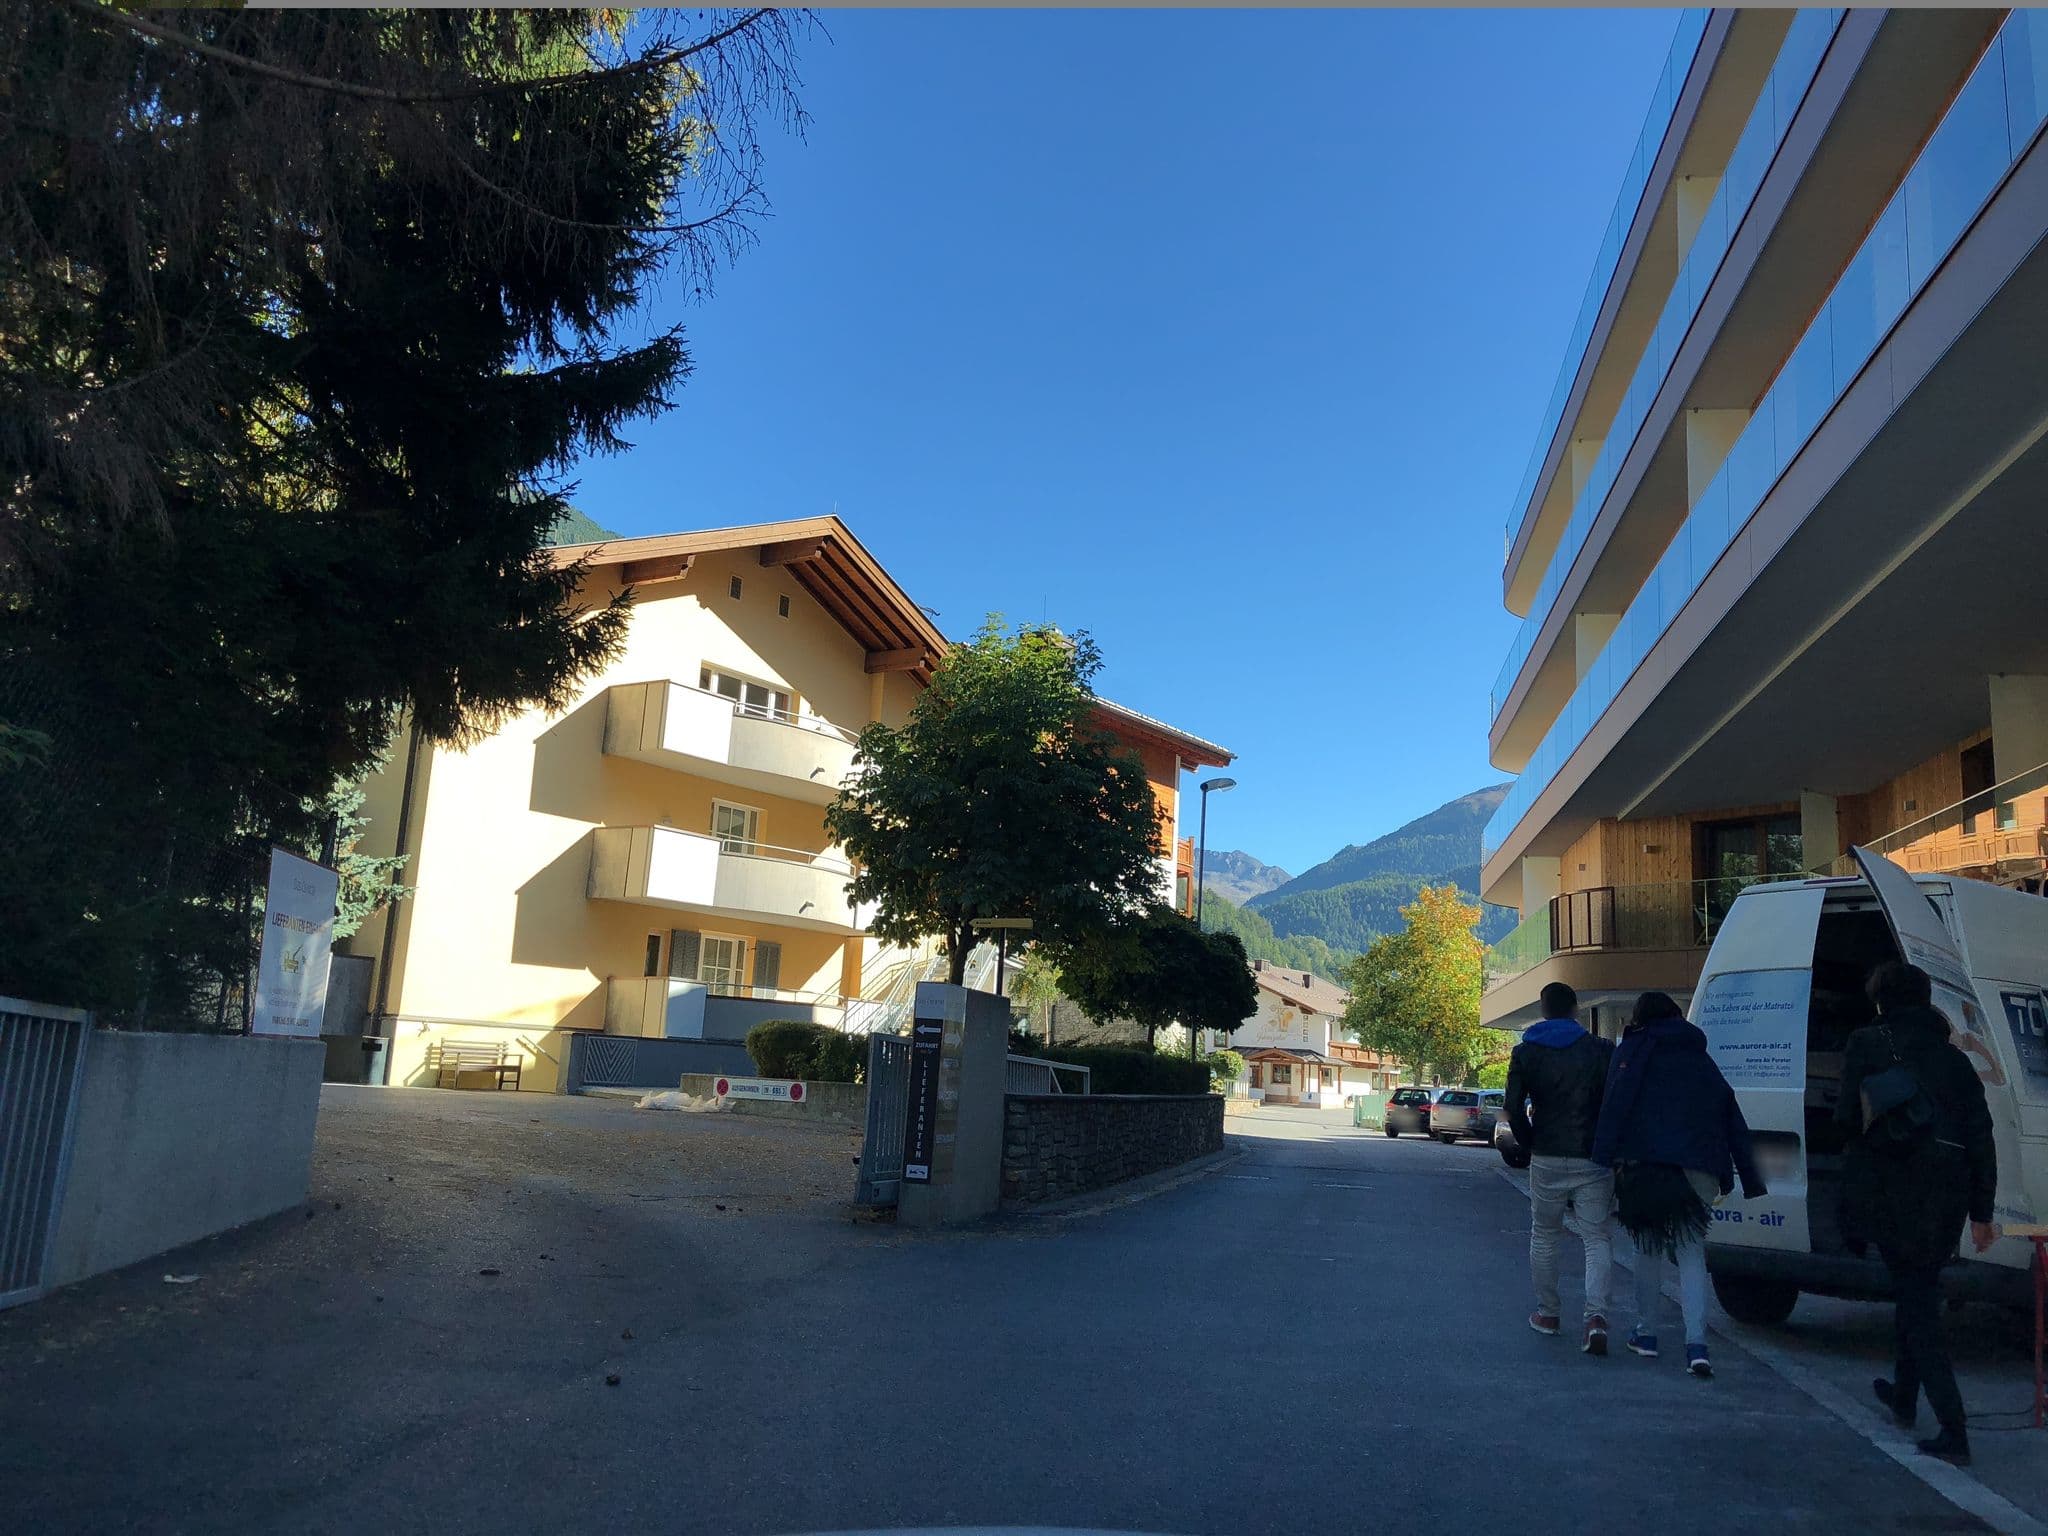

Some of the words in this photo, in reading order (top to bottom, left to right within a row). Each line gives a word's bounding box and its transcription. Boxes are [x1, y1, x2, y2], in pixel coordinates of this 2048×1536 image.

[1719, 1042, 1791, 1050] www.aurora-air.at
[915, 1060, 928, 1160] LIEFERANTEN
[1759, 1210, 1785, 1227] air
